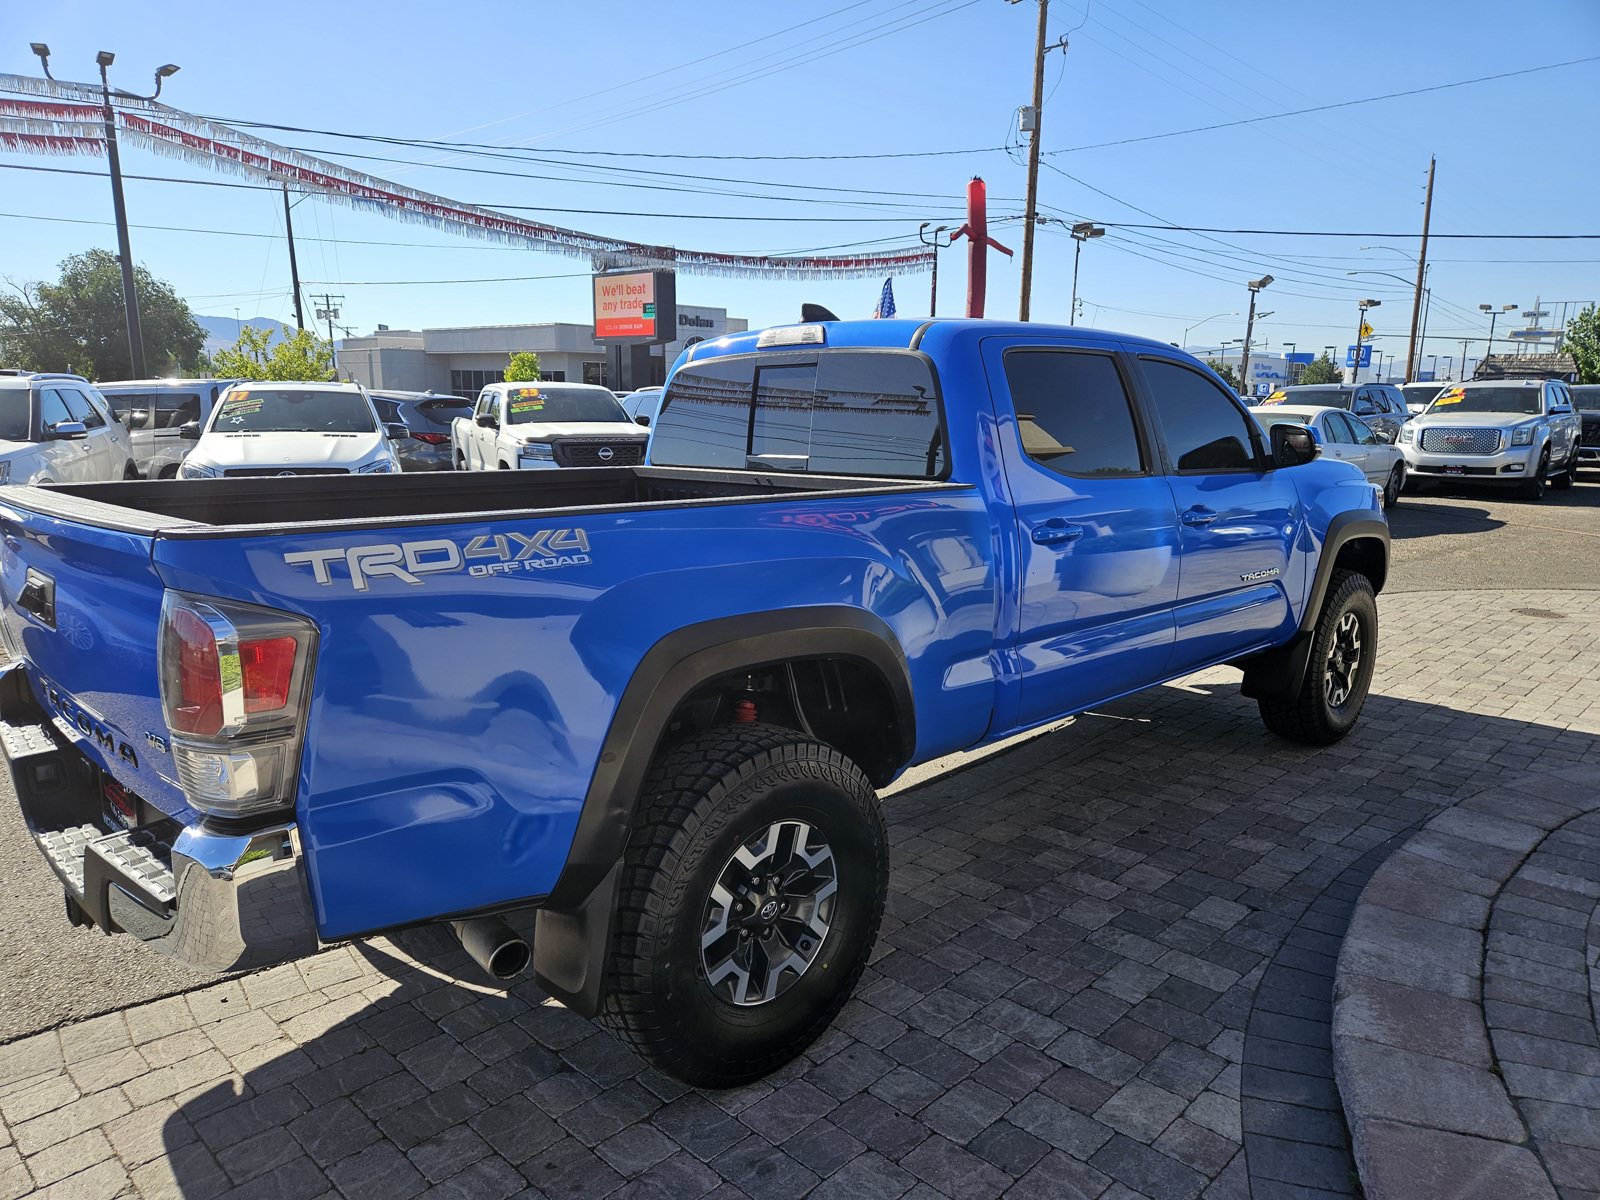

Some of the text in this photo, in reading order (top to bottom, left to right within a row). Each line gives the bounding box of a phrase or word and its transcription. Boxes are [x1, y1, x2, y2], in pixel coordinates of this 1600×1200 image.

[602, 283, 646, 297] We'll beat
[603, 301, 618, 312] any
[620, 297, 643, 310] trade
[679, 313, 714, 328] Dolan
[283, 539, 465, 592] TRD
[468, 554, 592, 577] OFF ROAD
[1240, 567, 1280, 581] TACOMA
[39, 676, 139, 769] TACOMA
